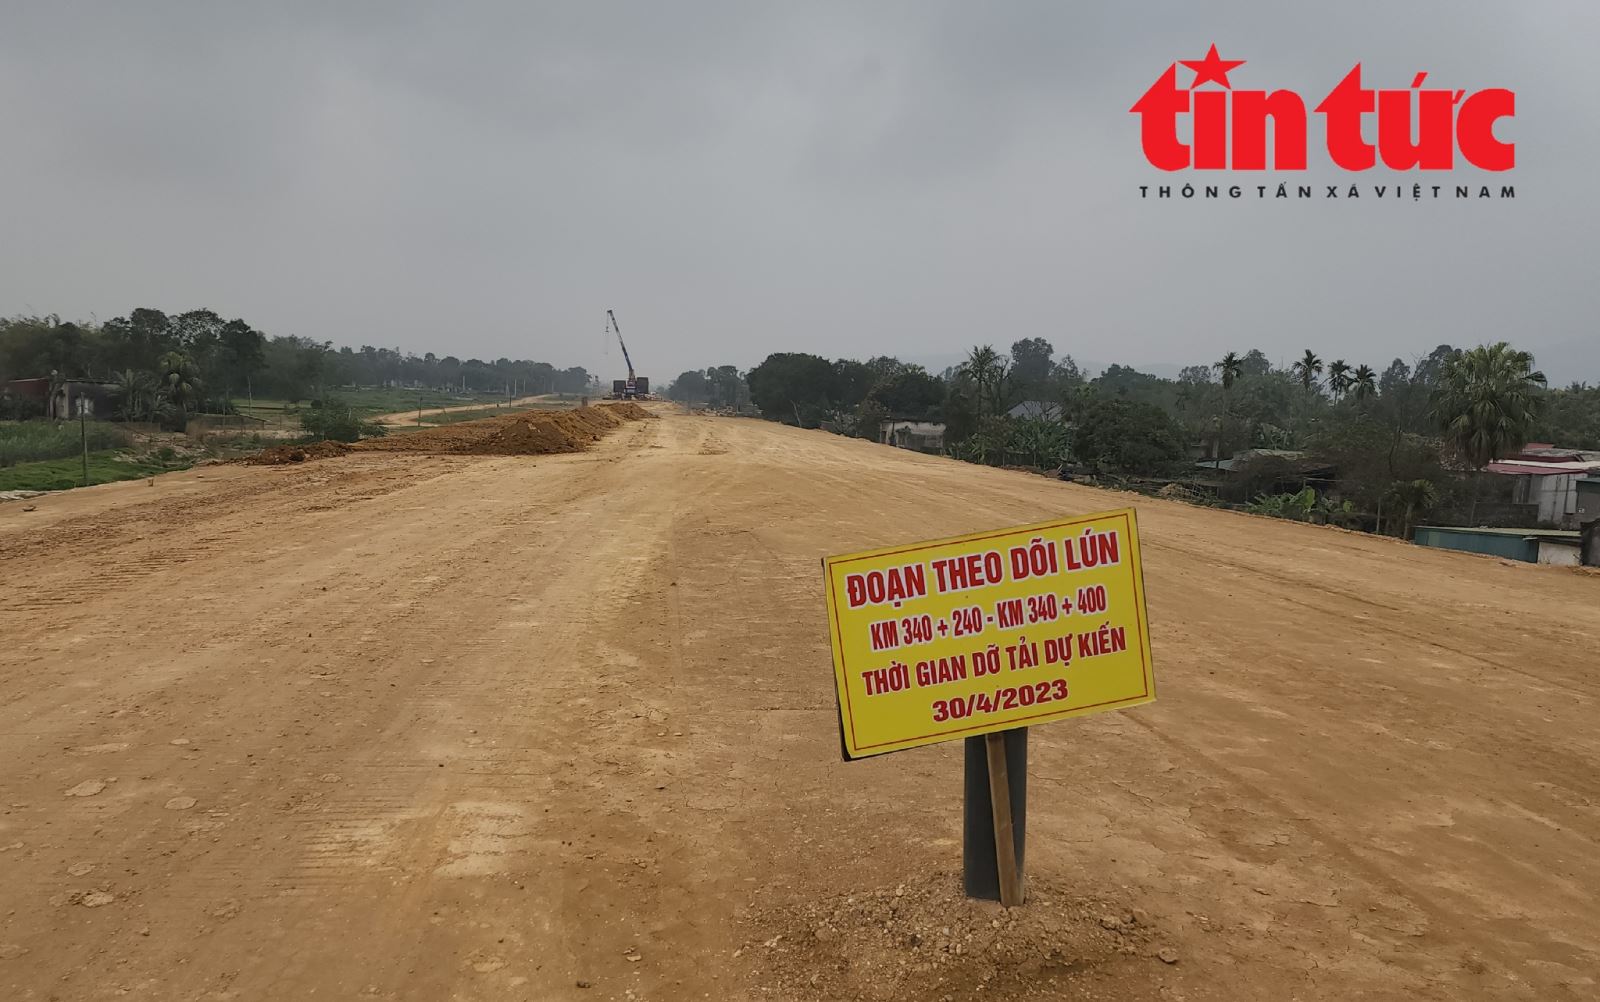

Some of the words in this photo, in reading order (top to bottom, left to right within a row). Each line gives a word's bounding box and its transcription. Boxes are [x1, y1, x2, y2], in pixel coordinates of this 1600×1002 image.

[848, 564, 926, 607] ĐOẠN
[932, 551, 1003, 592] THEO
[1011, 537, 1058, 579] DÕI
[1065, 529, 1119, 571] LÚN
[871, 621, 898, 650] KM
[903, 614, 933, 643] 340
[954, 606, 983, 637] 240
[997, 598, 1024, 628] KM
[1029, 593, 1058, 623] 340
[1077, 585, 1107, 613] 400
[862, 661, 910, 696] THỜI
[916, 655, 967, 687] GIAN
[973, 643, 1001, 677] DỠ
[1005, 636, 1039, 672] TẢI
[1045, 633, 1074, 669] DỰ
[1079, 621, 1127, 658] KIẾN
[932, 678, 1069, 723] 30/4/2023
